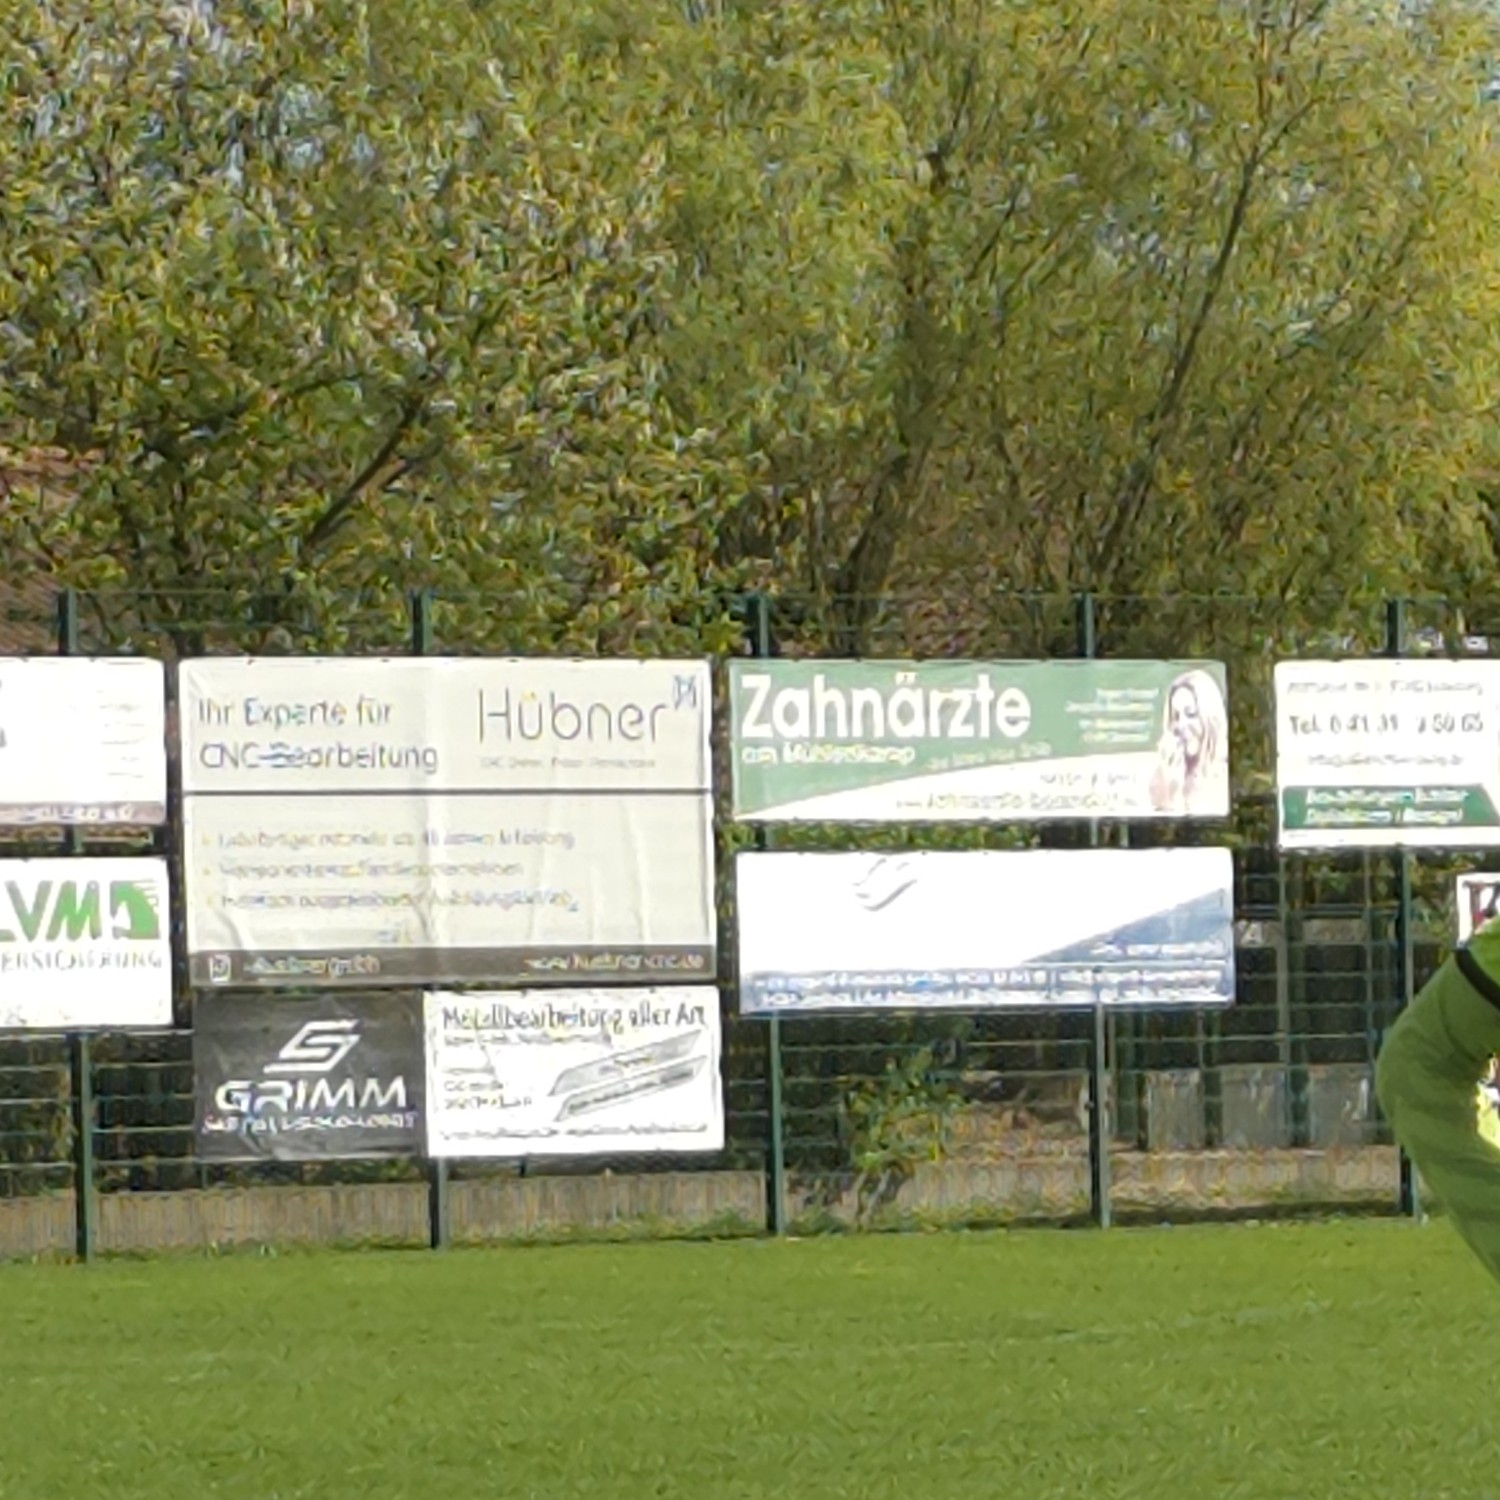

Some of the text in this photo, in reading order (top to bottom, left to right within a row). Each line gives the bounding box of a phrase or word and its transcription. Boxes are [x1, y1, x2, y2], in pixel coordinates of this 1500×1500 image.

[198, 697, 232, 725] Ihr
[478, 687, 668, 744] Hübner
[741, 672, 1031, 738] Zahnärzte
[214, 1076, 407, 1112] GRIMM
